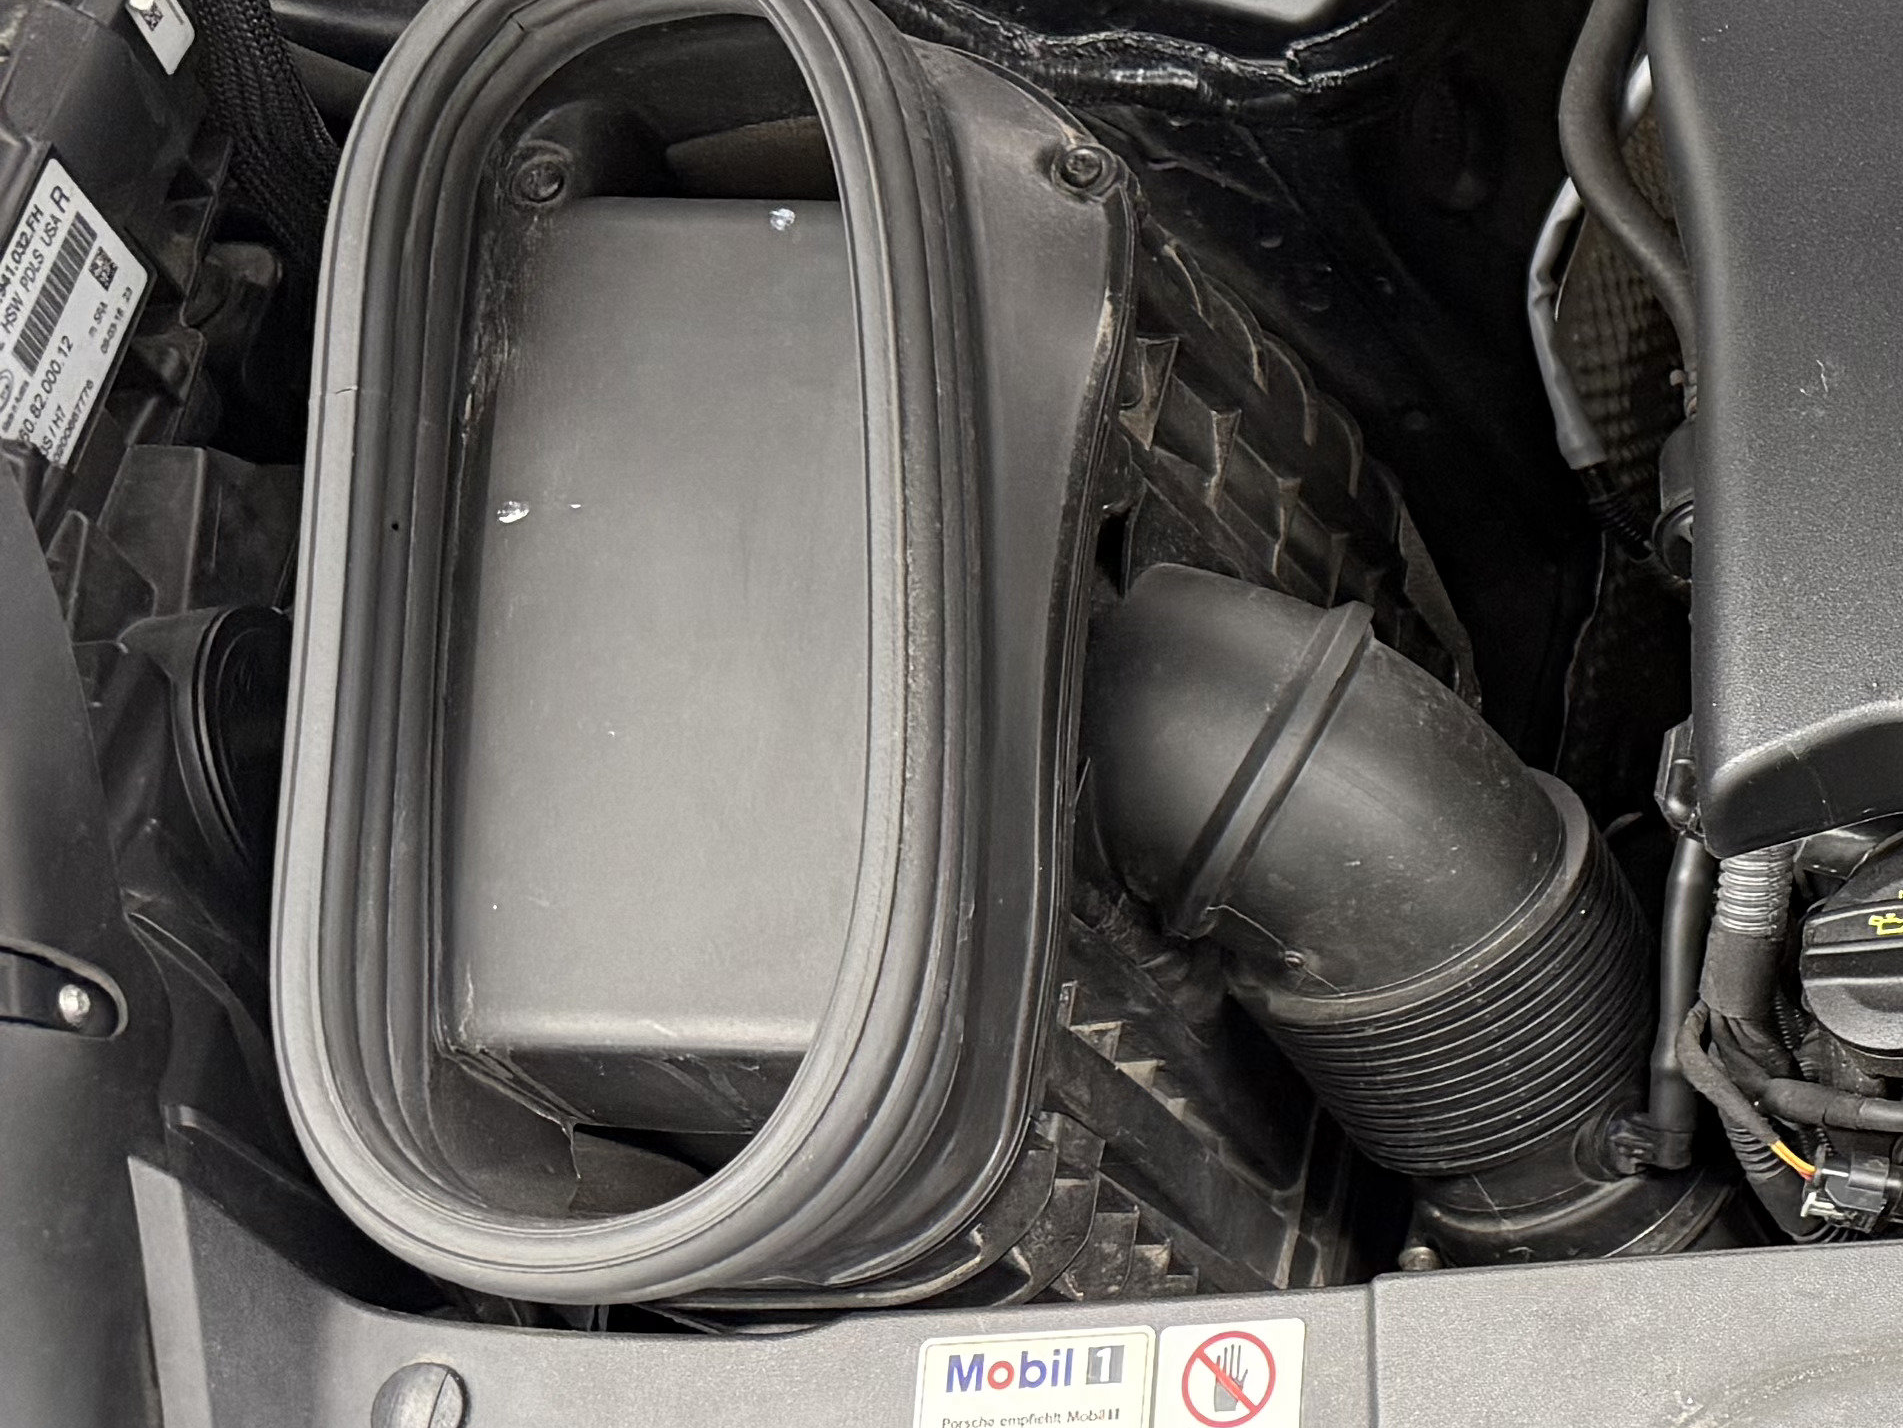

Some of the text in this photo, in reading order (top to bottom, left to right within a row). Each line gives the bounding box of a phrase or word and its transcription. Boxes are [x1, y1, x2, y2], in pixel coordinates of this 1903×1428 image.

[49, 183, 70, 215] R
[0, 213, 61, 333] HSW PDLS USA
[52, 404, 65, 429] H7
[946, 1345, 1121, 1393] Mobil 1
